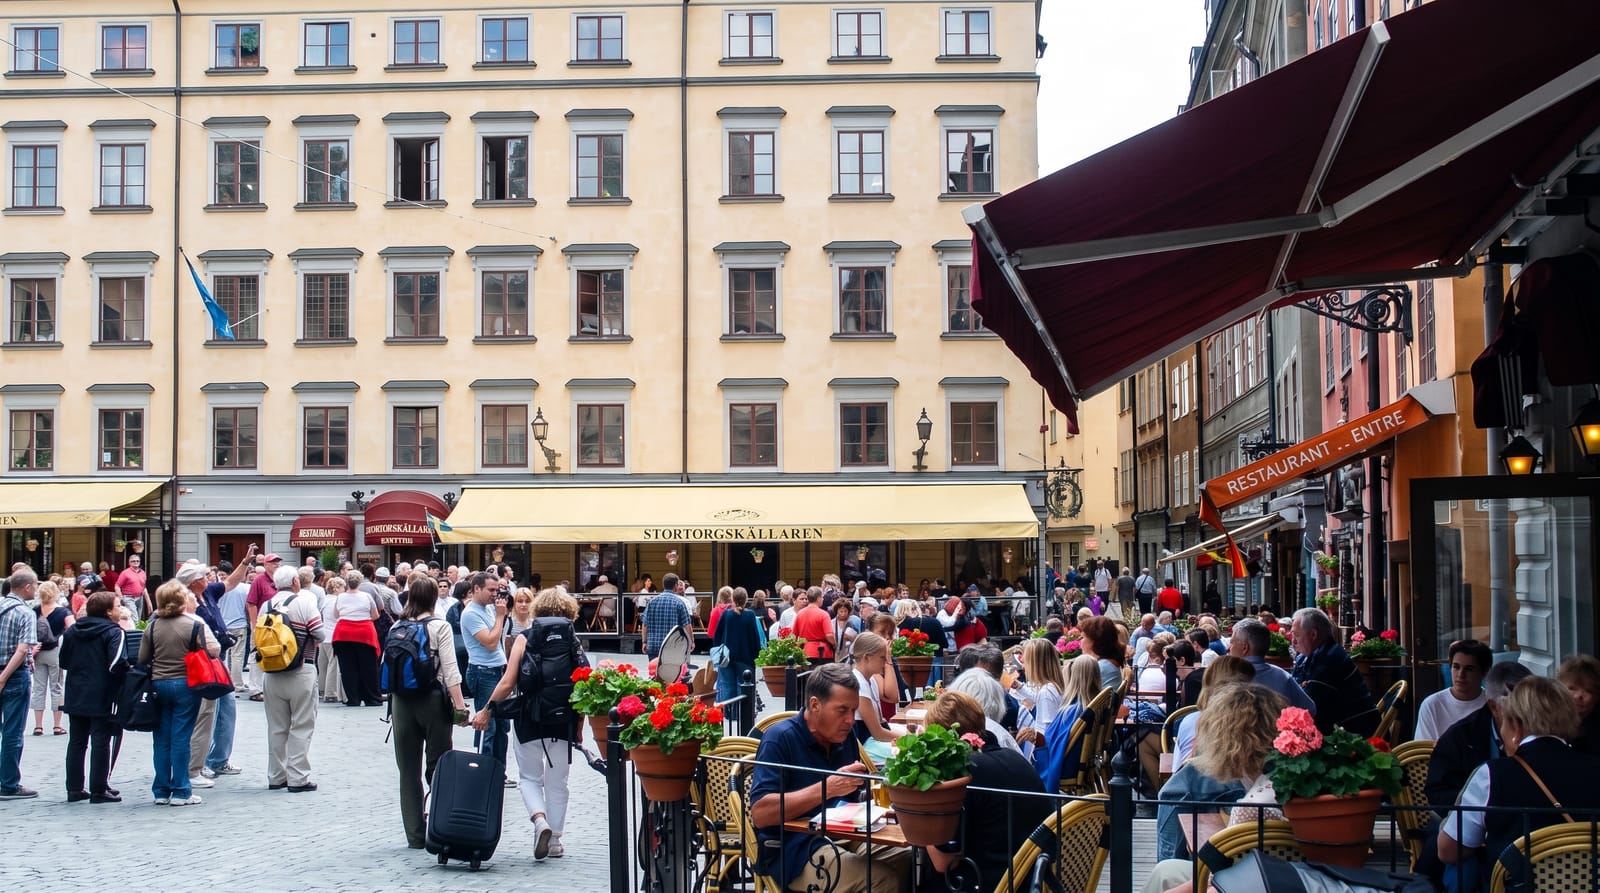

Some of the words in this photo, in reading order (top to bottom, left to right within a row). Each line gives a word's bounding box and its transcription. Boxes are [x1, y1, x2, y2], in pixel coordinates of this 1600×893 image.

[1226, 441, 1331, 495] RESTAURANT
[1351, 409, 1406, 443] ENTRE
[0, 516, 17, 525] EN
[298, 528, 337, 538] RESTAURANT
[643, 526, 824, 540] STORTORGSKÄLLAREN
